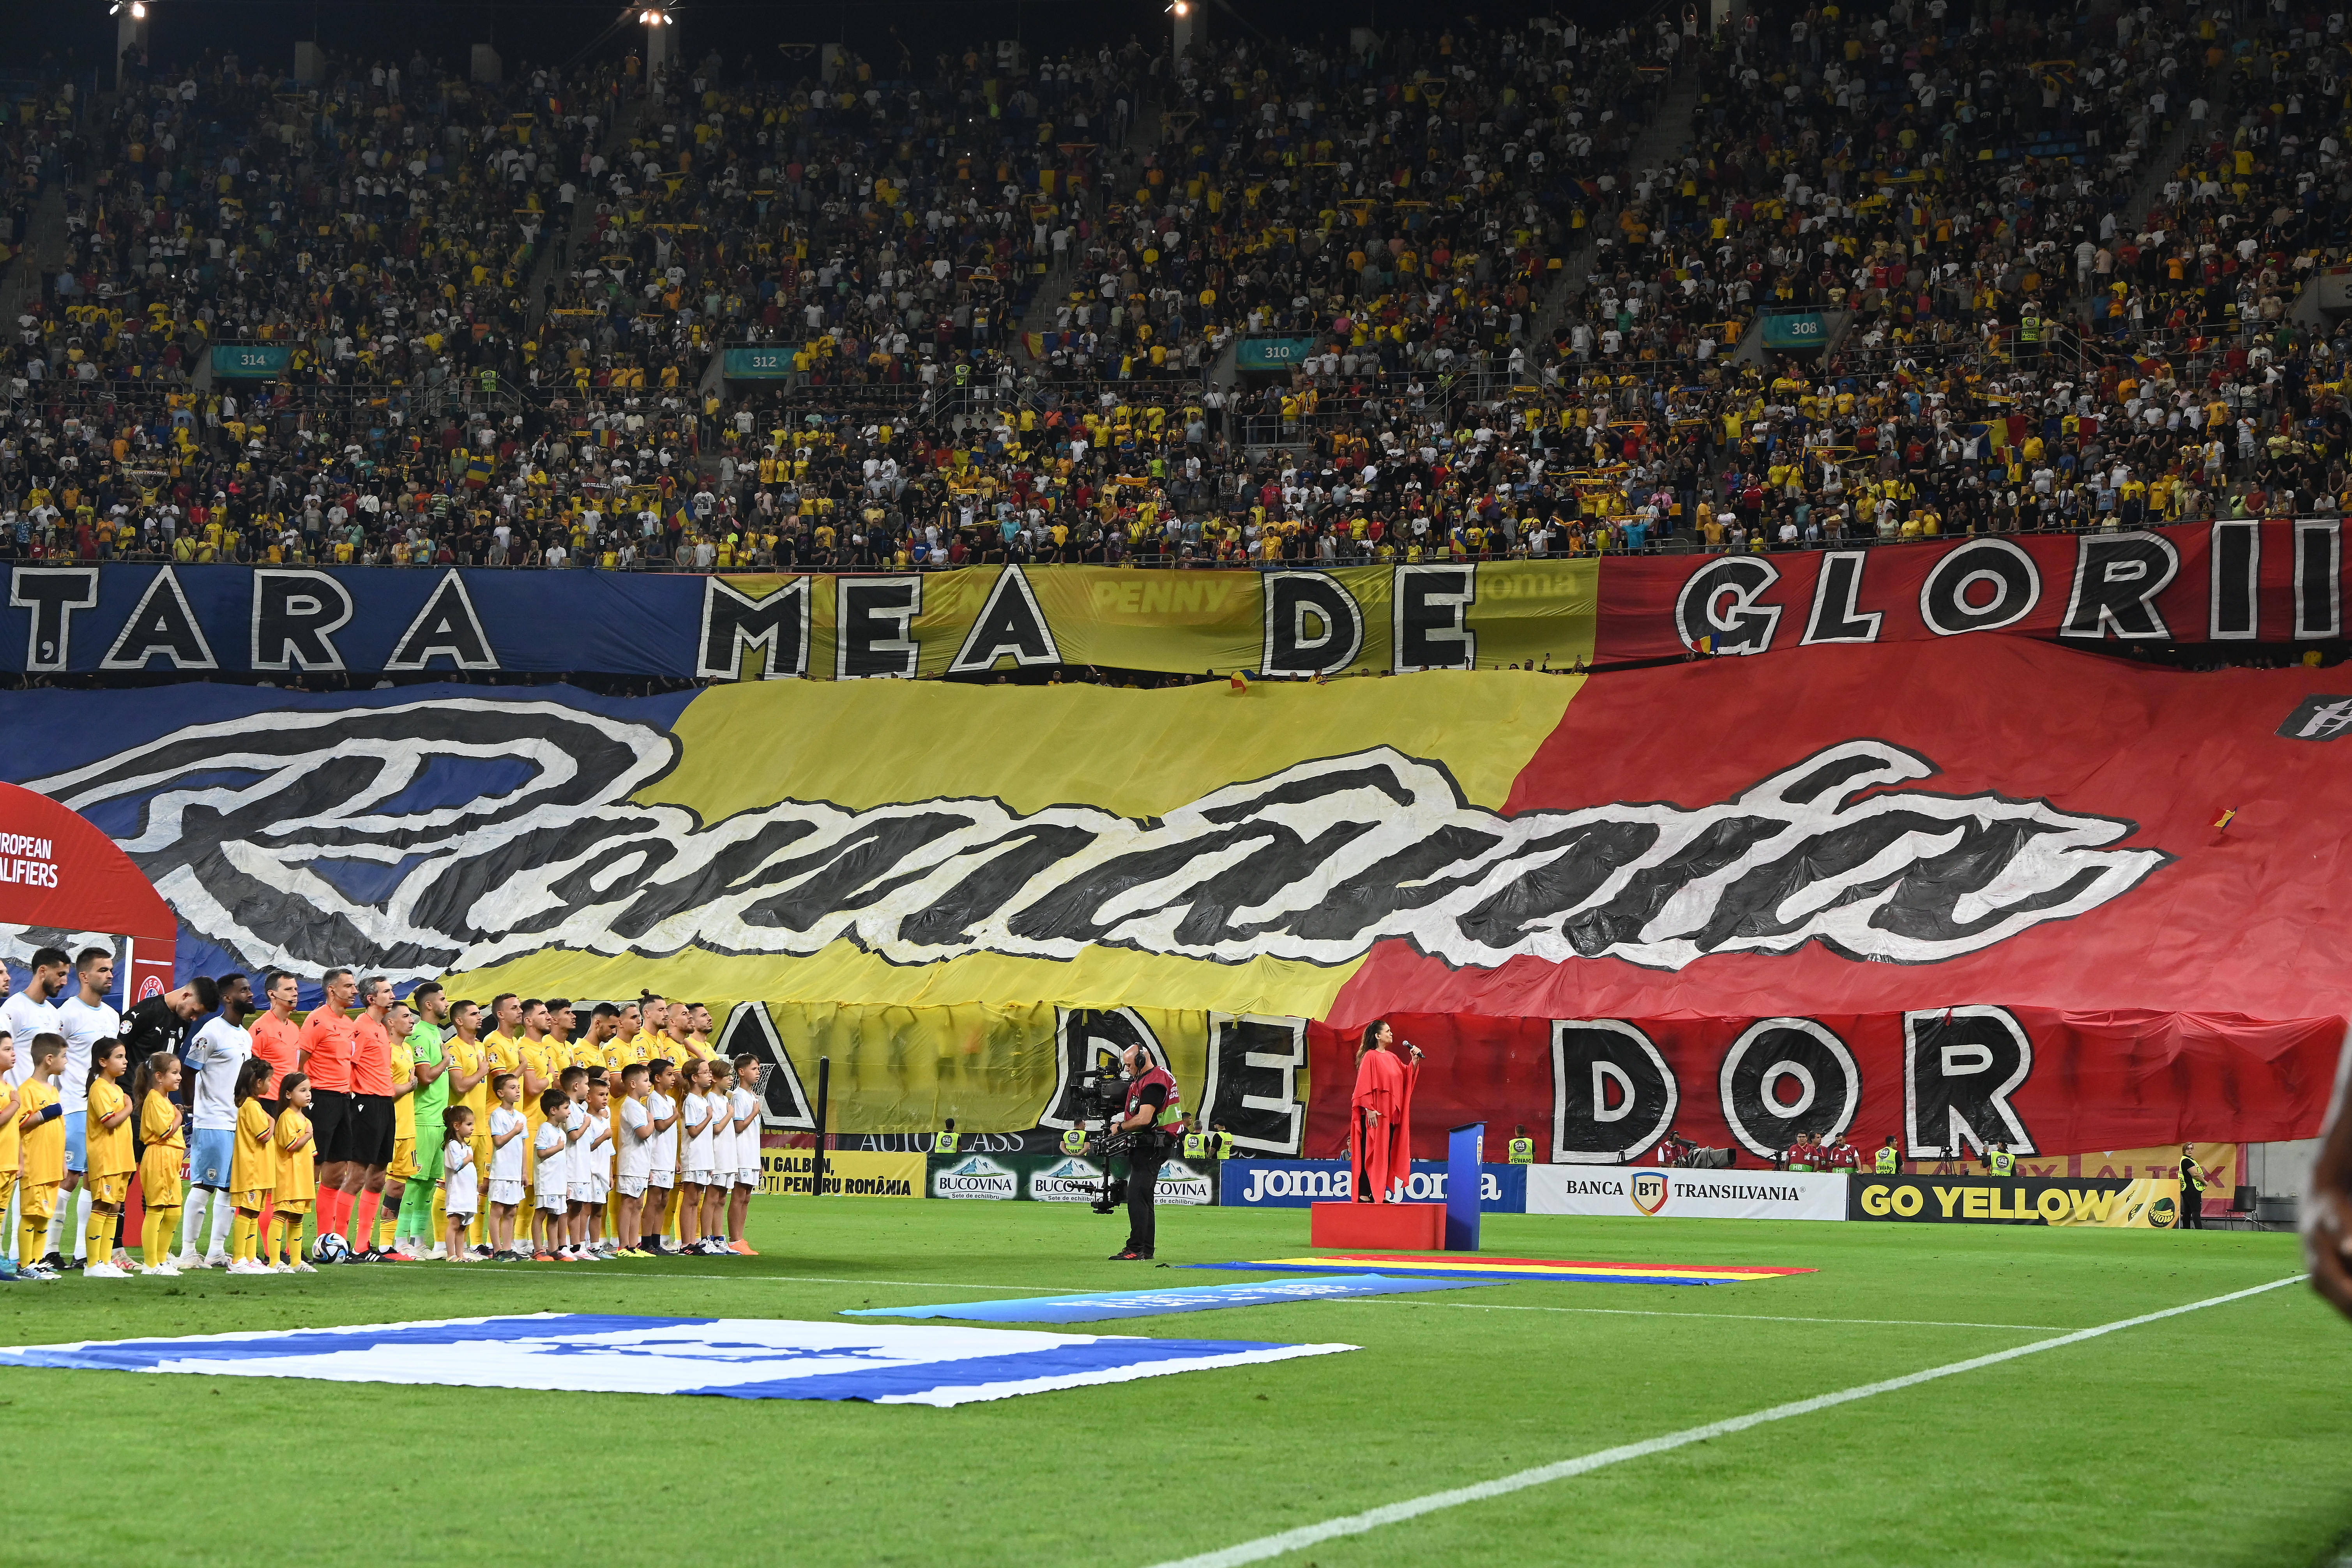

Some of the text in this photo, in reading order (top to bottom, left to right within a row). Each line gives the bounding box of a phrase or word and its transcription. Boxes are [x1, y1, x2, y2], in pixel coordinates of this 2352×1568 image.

[1792, 322, 1817, 334] 308
[241, 355, 265, 366] 314
[1265, 346, 1289, 358] 310
[753, 357, 777, 367] 312
[696, 563, 1064, 680] MEA
[1260, 562, 1477, 677] DE
[1674, 519, 2341, 656] GLORII
[0, 832, 52, 859] ROPEAN
[144, 979, 161, 992] UEFA
[1550, 1004, 2041, 1166] DOR
[784, 1177, 841, 1194] PENRU
[845, 1175, 911, 1195] ROMÂNIA
[939, 1177, 1012, 1191] BUCOVINA
[1566, 1180, 1799, 1201] BANCA BT TRANSILVANIA
[1861, 1185, 2116, 1221] GO YELLOW
